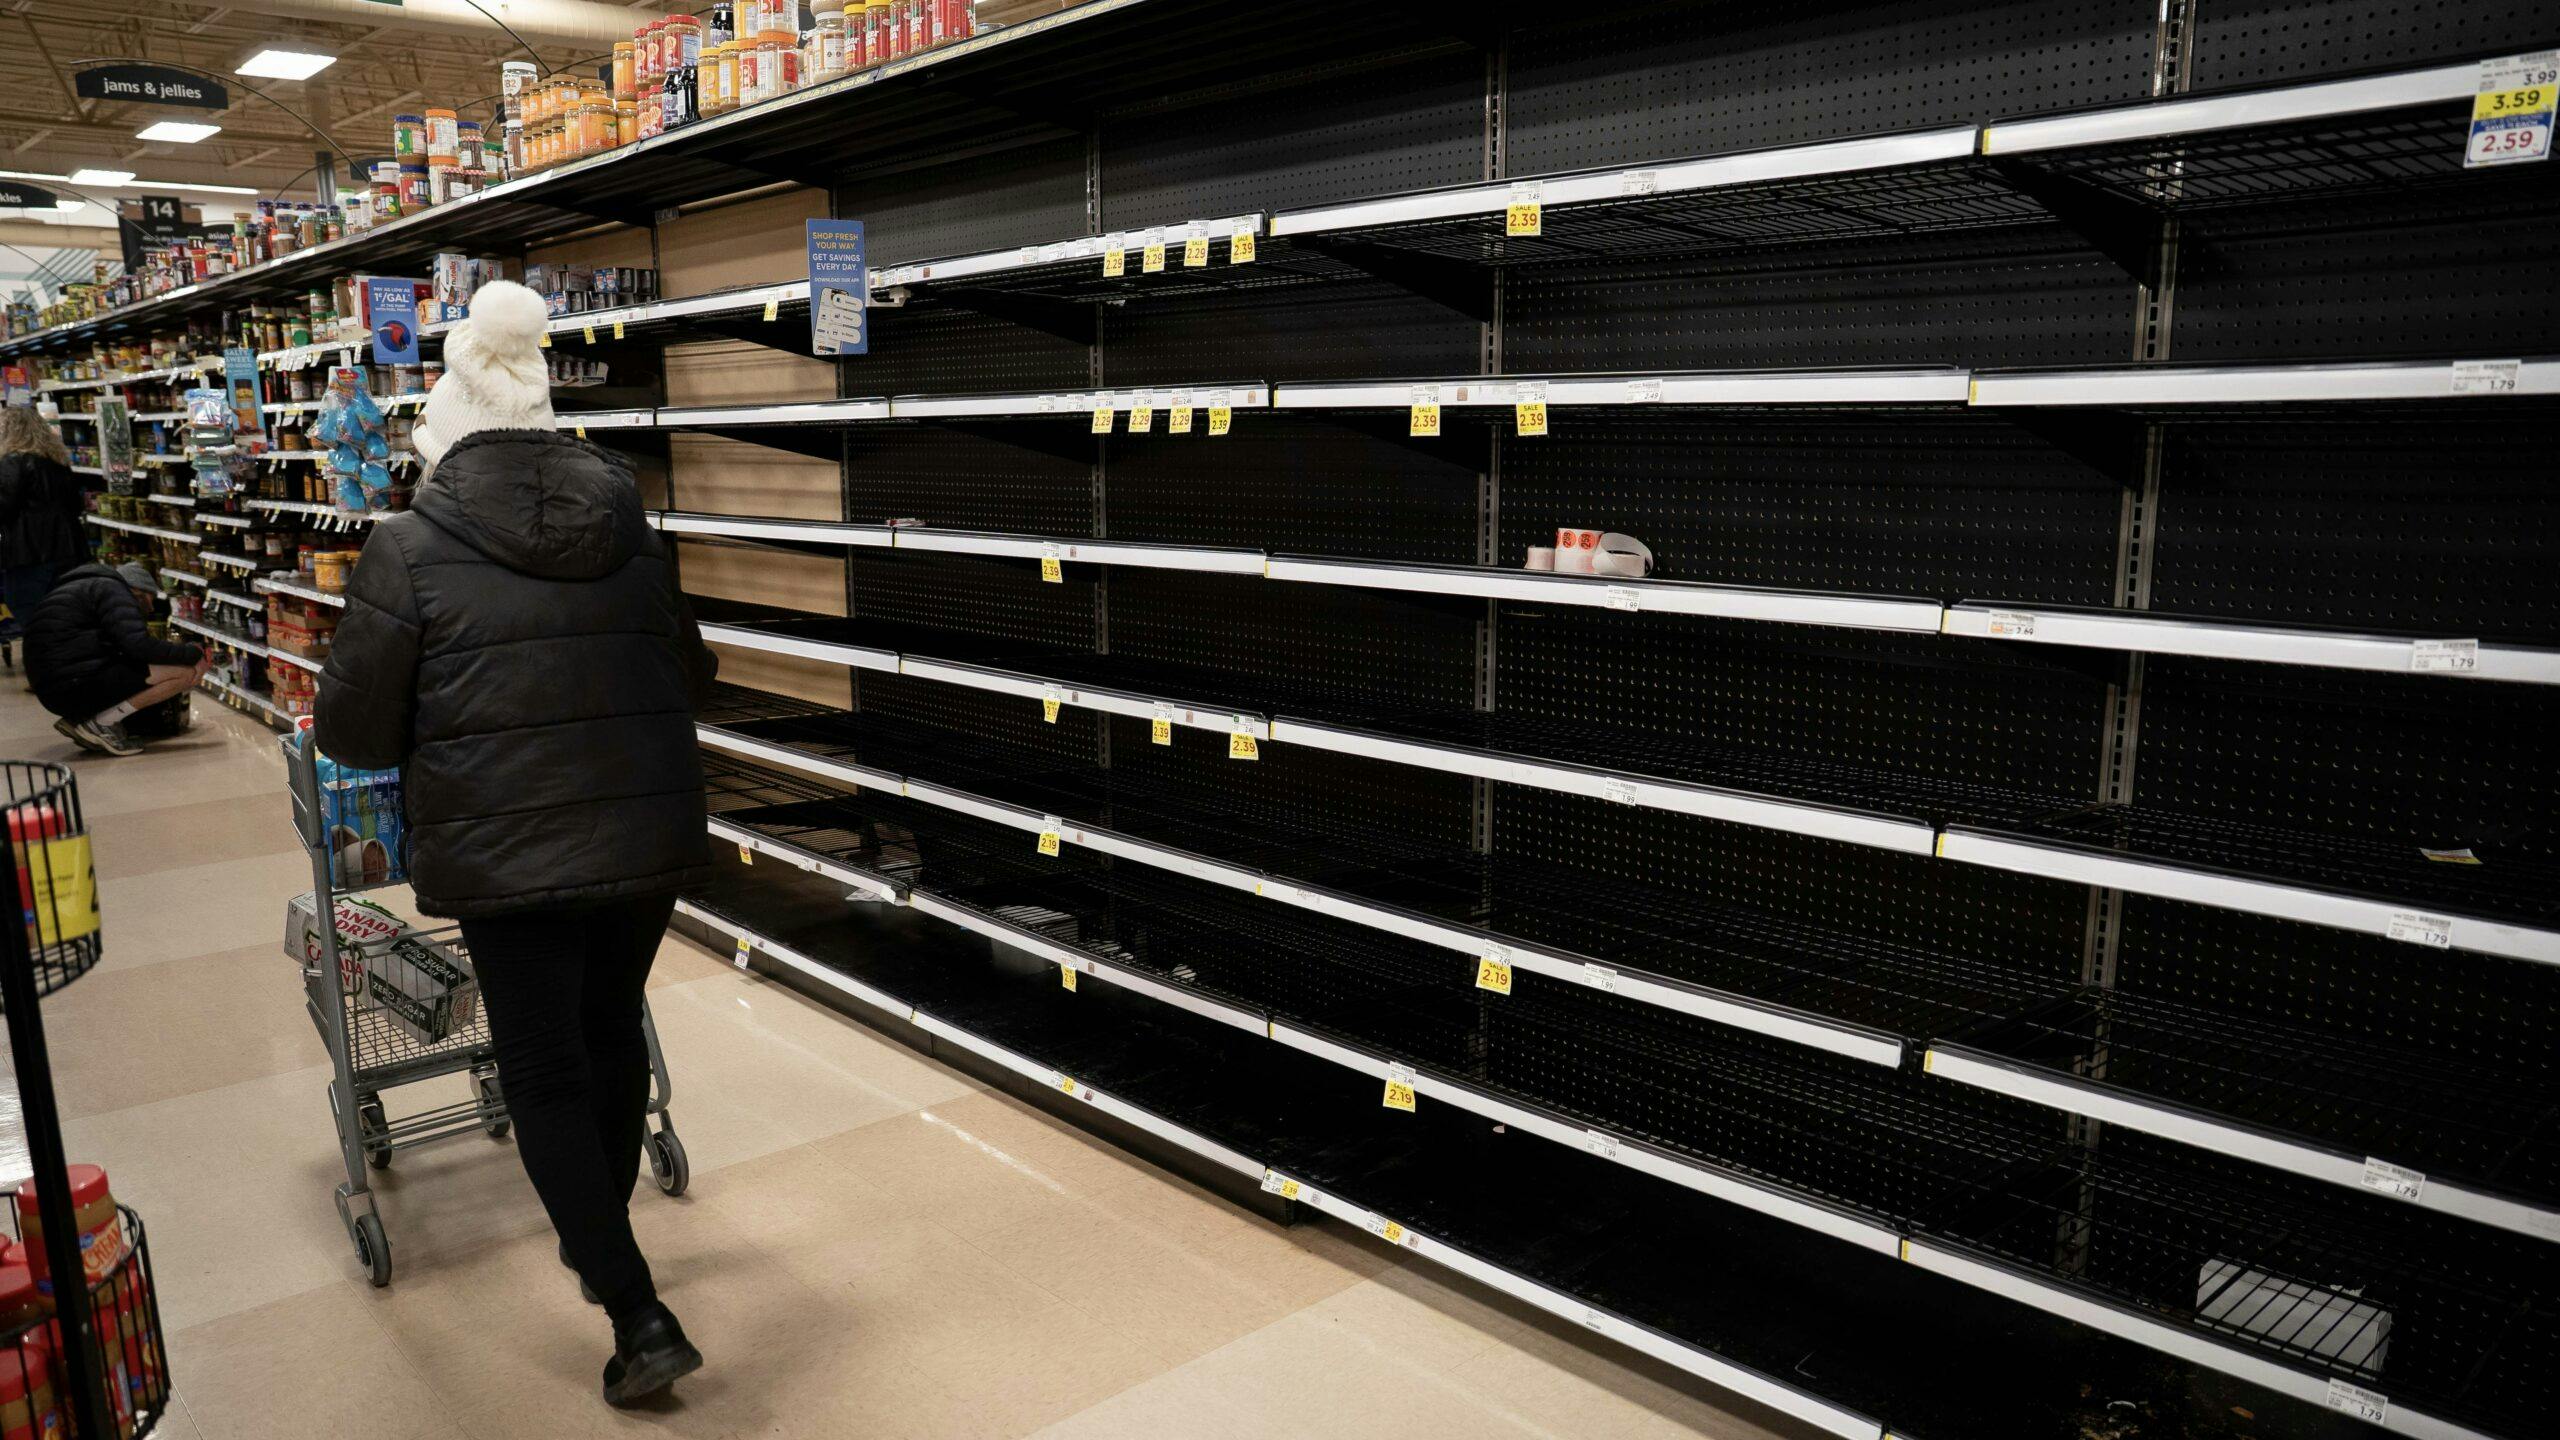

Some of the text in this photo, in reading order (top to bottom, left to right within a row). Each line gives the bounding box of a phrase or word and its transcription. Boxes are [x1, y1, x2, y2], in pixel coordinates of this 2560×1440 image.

[2524, 70, 2557, 86] 3.99
[103, 78, 202, 100] jams & jellies
[2493, 89, 2540, 110] 3.59
[2482, 130, 2533, 153] 2.59
[149, 200, 175, 218] 14
[1509, 213, 1538, 227] 2.39
[812, 232, 833, 240] SHOP
[1187, 247, 1206, 259] 2.29
[1234, 242, 1253, 256] 2.39
[812, 253, 861, 262] GET SAVINGS
[1145, 253, 1163, 265] 2.29
[816, 262, 858, 271] EVERY DAY.
[1106, 258, 1122, 270] 2.29
[2490, 380, 2515, 390] 1.79
[1095, 416, 1111, 427] 2.29
[1132, 415, 1150, 425] 2.29
[1172, 415, 1190, 426] 2.29
[1212, 419, 1227, 430] 2.39
[1413, 415, 1437, 427] 2.39
[1520, 413, 1543, 426] 2.39
[1043, 565, 1059, 576] 2.39
[2451, 658, 2474, 667] 1.79
[1154, 727, 1169, 738] 2.39
[1233, 741, 1256, 753] 2.39
[1041, 837, 1057, 850] 2.19
[335, 920, 376, 939] DRY
[2424, 932, 2448, 945] 1.79
[425, 958, 457, 981] SUGAR
[1489, 962, 1504, 971] SALE
[1482, 968, 1508, 986] 2.19
[1393, 1082, 1406, 1091] SALE
[1389, 1088, 1412, 1104] 2.19
[1282, 1184, 1298, 1196] 2.39
[2395, 1184, 2418, 1197] 1.79
[1385, 1226, 1401, 1238] 2.39
[2359, 1405, 2382, 1421] 1.79
